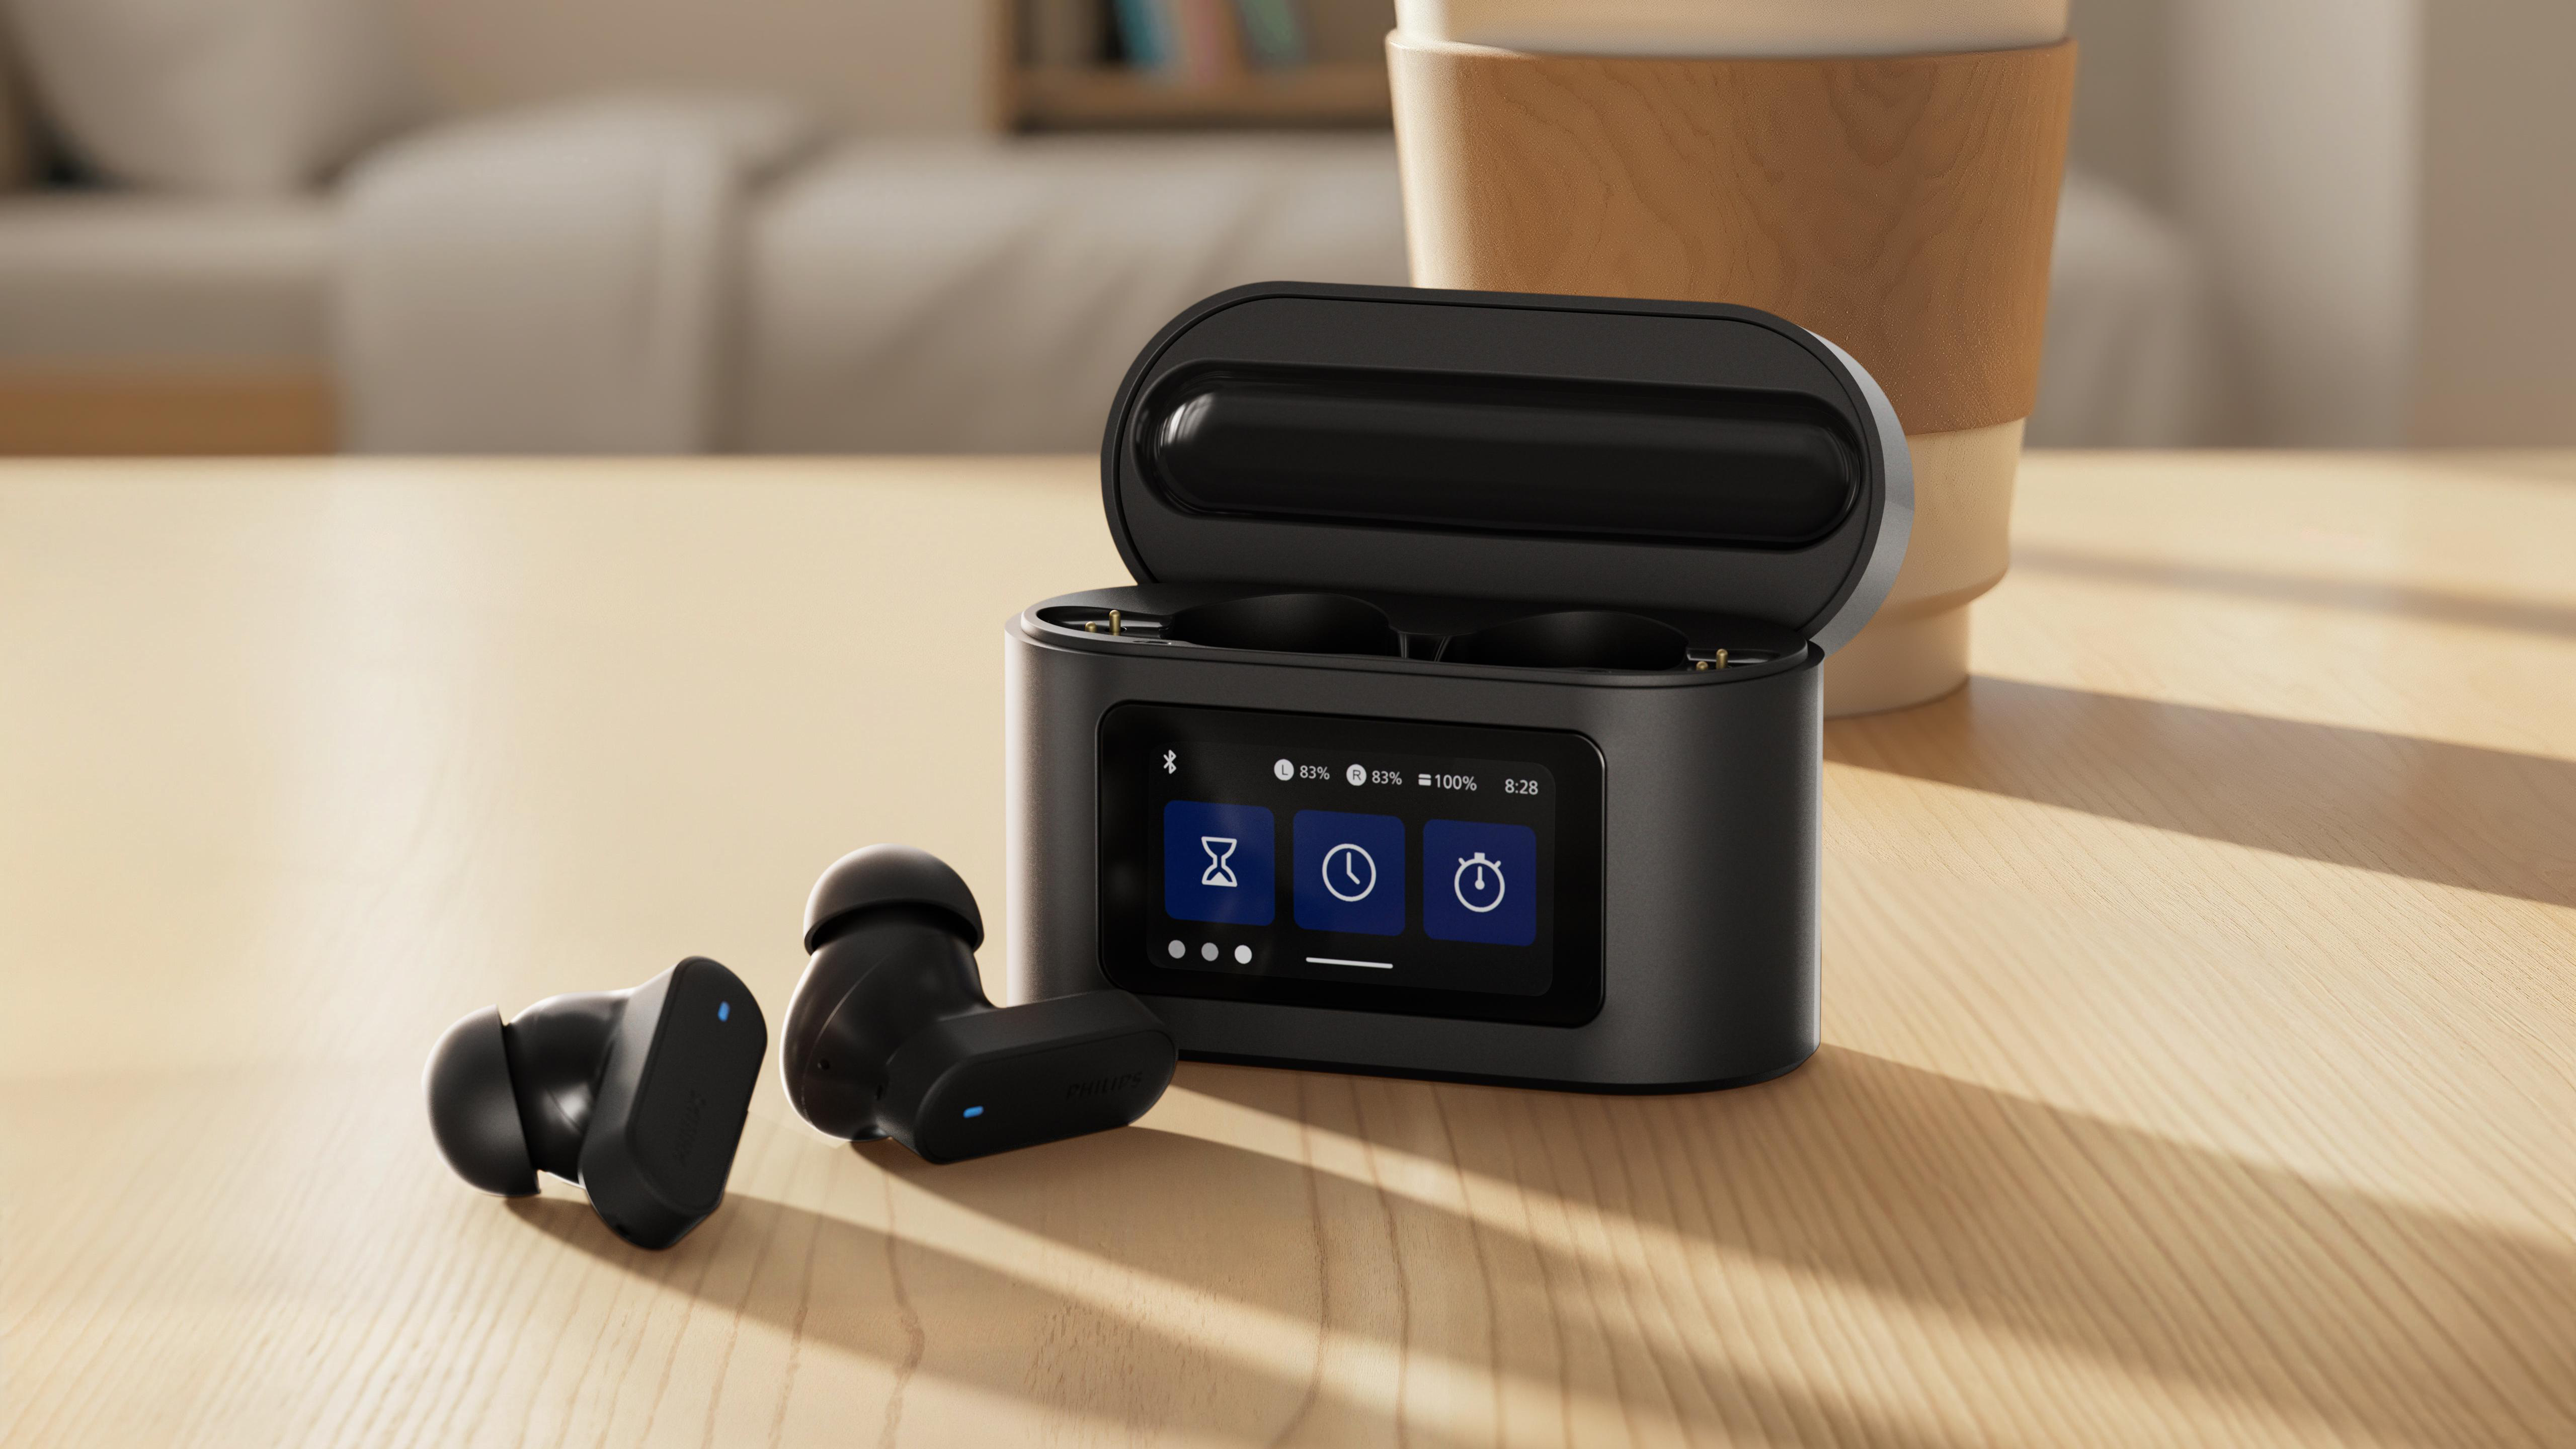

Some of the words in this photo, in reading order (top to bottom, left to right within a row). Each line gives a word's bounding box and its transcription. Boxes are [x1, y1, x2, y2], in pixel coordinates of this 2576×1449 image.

[1300, 765, 1330, 780] 83%
[1372, 770, 1403, 785] 83%
[1435, 774, 1477, 791] 100%
[1505, 778, 1539, 795] 8:28
[1066, 1071, 1144, 1101] PHILIPS
